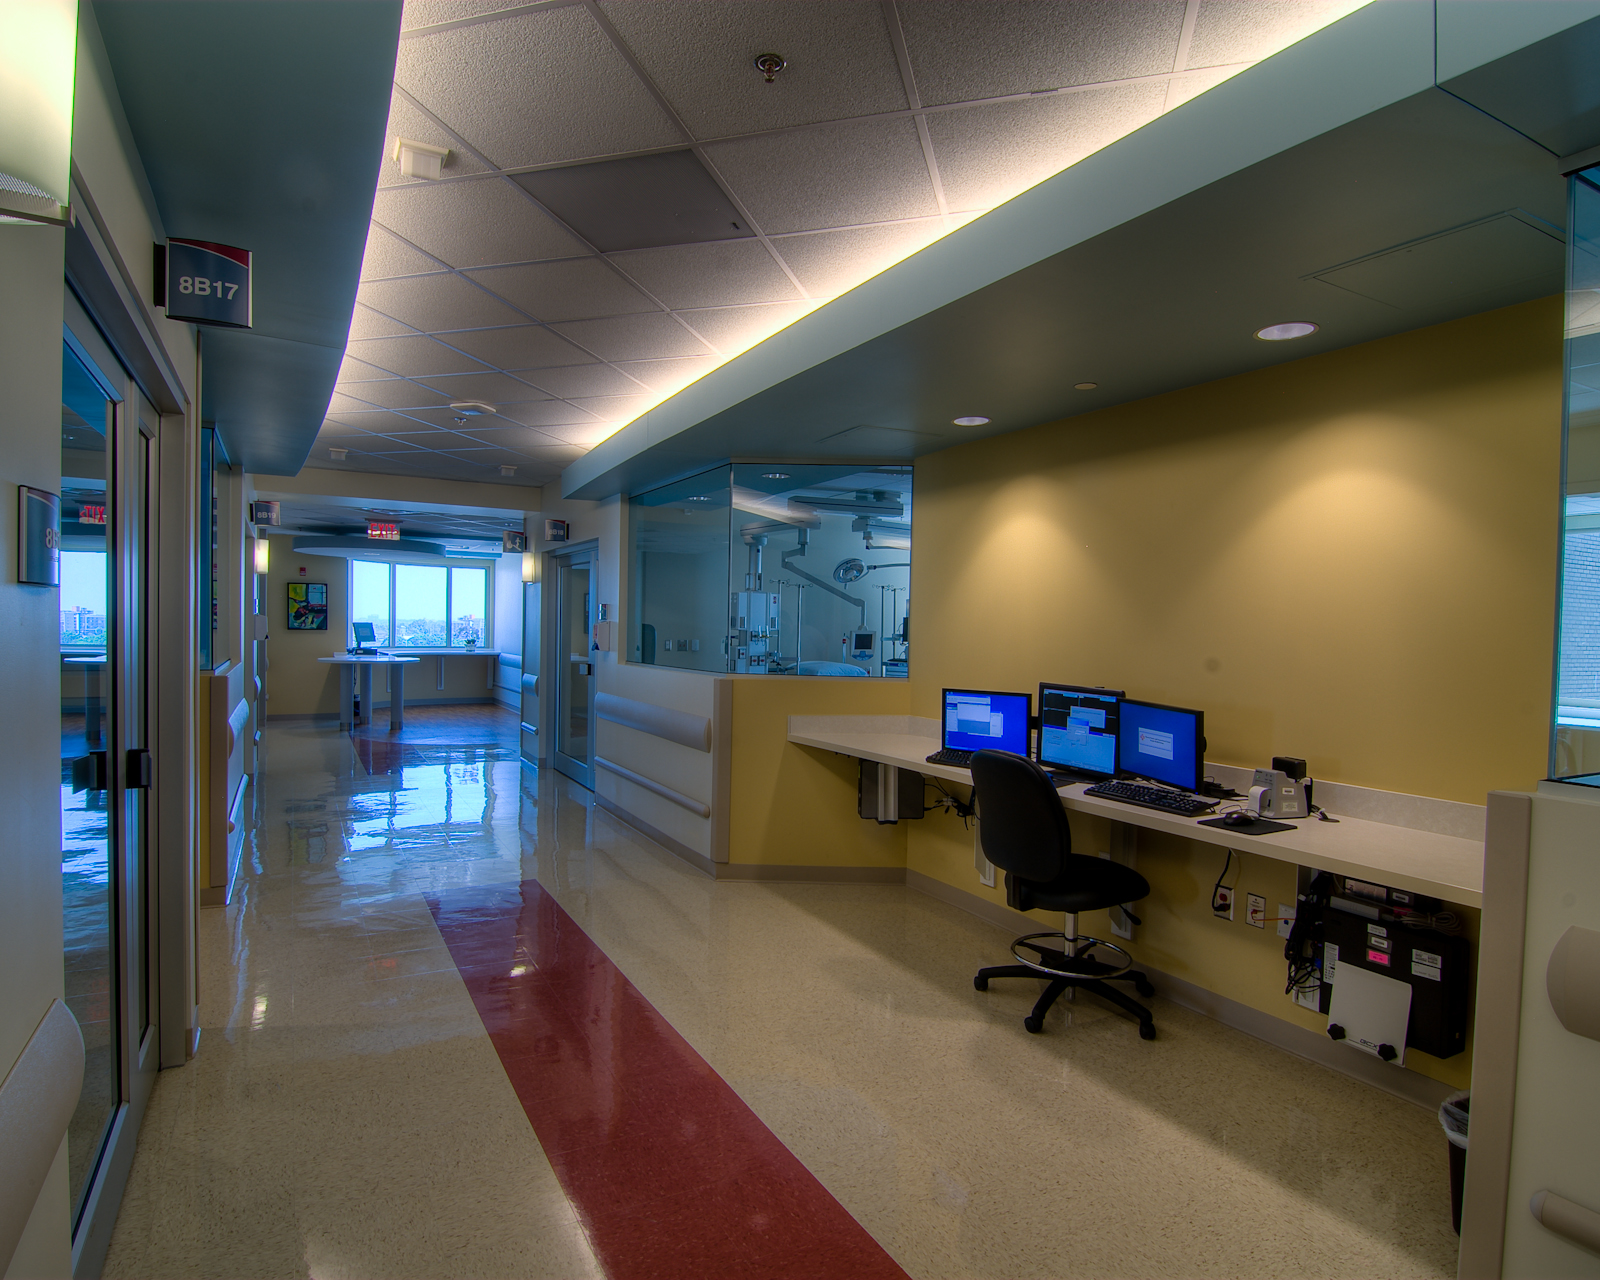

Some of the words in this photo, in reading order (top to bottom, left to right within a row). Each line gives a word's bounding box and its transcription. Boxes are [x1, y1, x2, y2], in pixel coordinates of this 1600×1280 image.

[179, 276, 239, 300] 8B17
[257, 511, 277, 519] 8B19
[370, 522, 396, 539] EXIT
